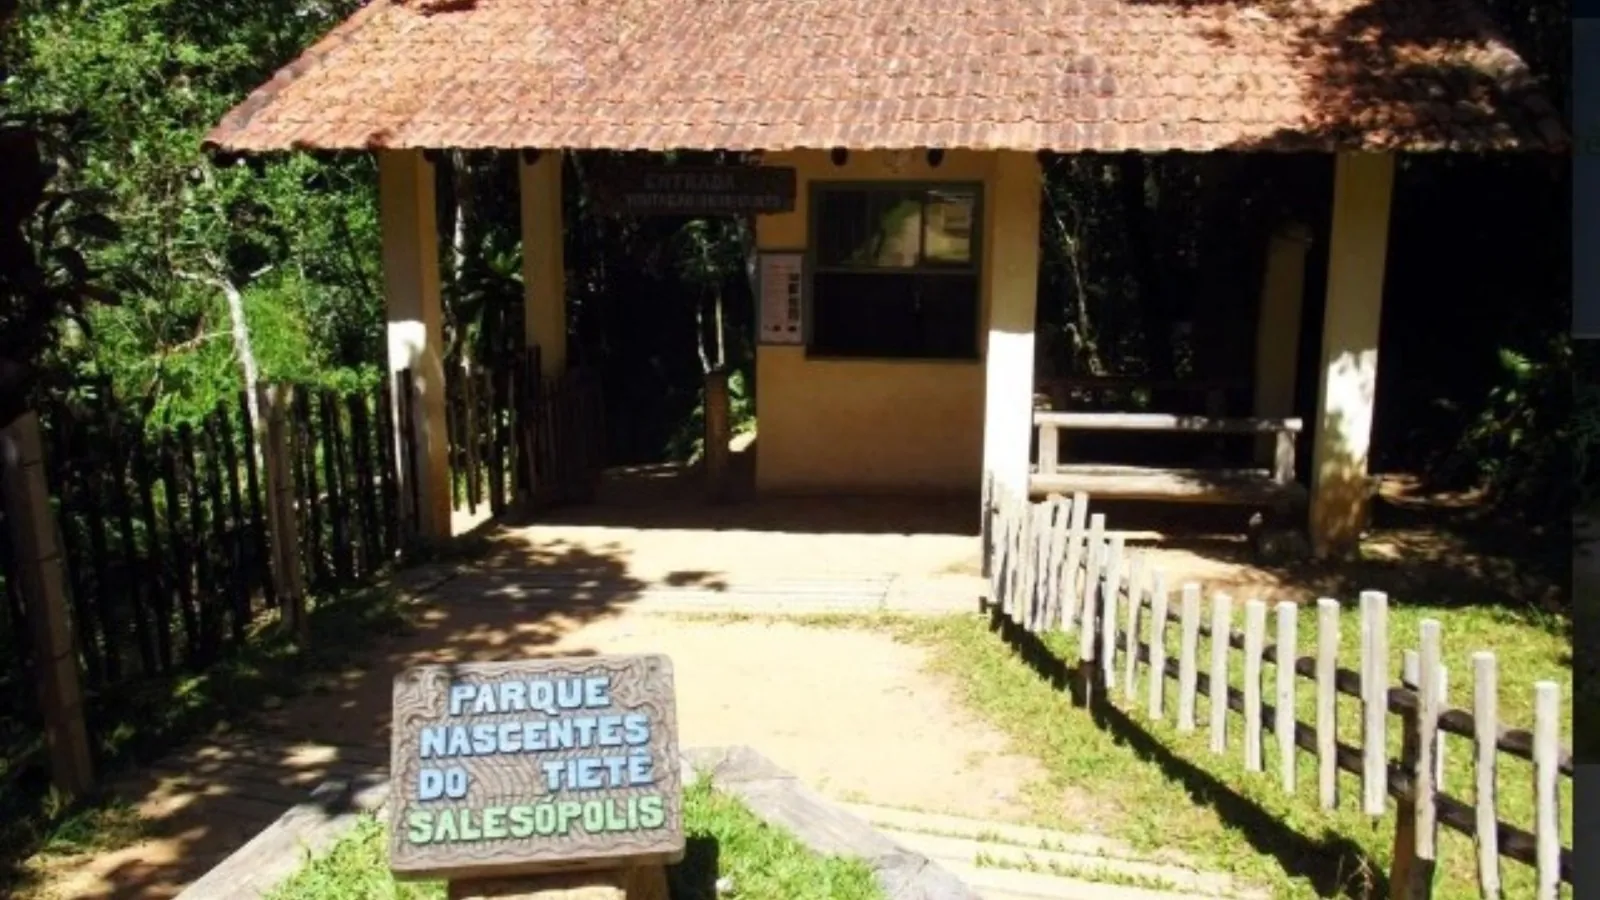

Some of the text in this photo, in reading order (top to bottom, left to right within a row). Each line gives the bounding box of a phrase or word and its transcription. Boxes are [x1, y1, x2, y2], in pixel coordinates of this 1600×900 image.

[645, 173, 735, 190] ENTRADA
[450, 677, 610, 716] PARQUE
[420, 714, 650, 758] NASCENTES
[419, 767, 468, 799] DO
[408, 796, 665, 844] SALESÓPOLIS
